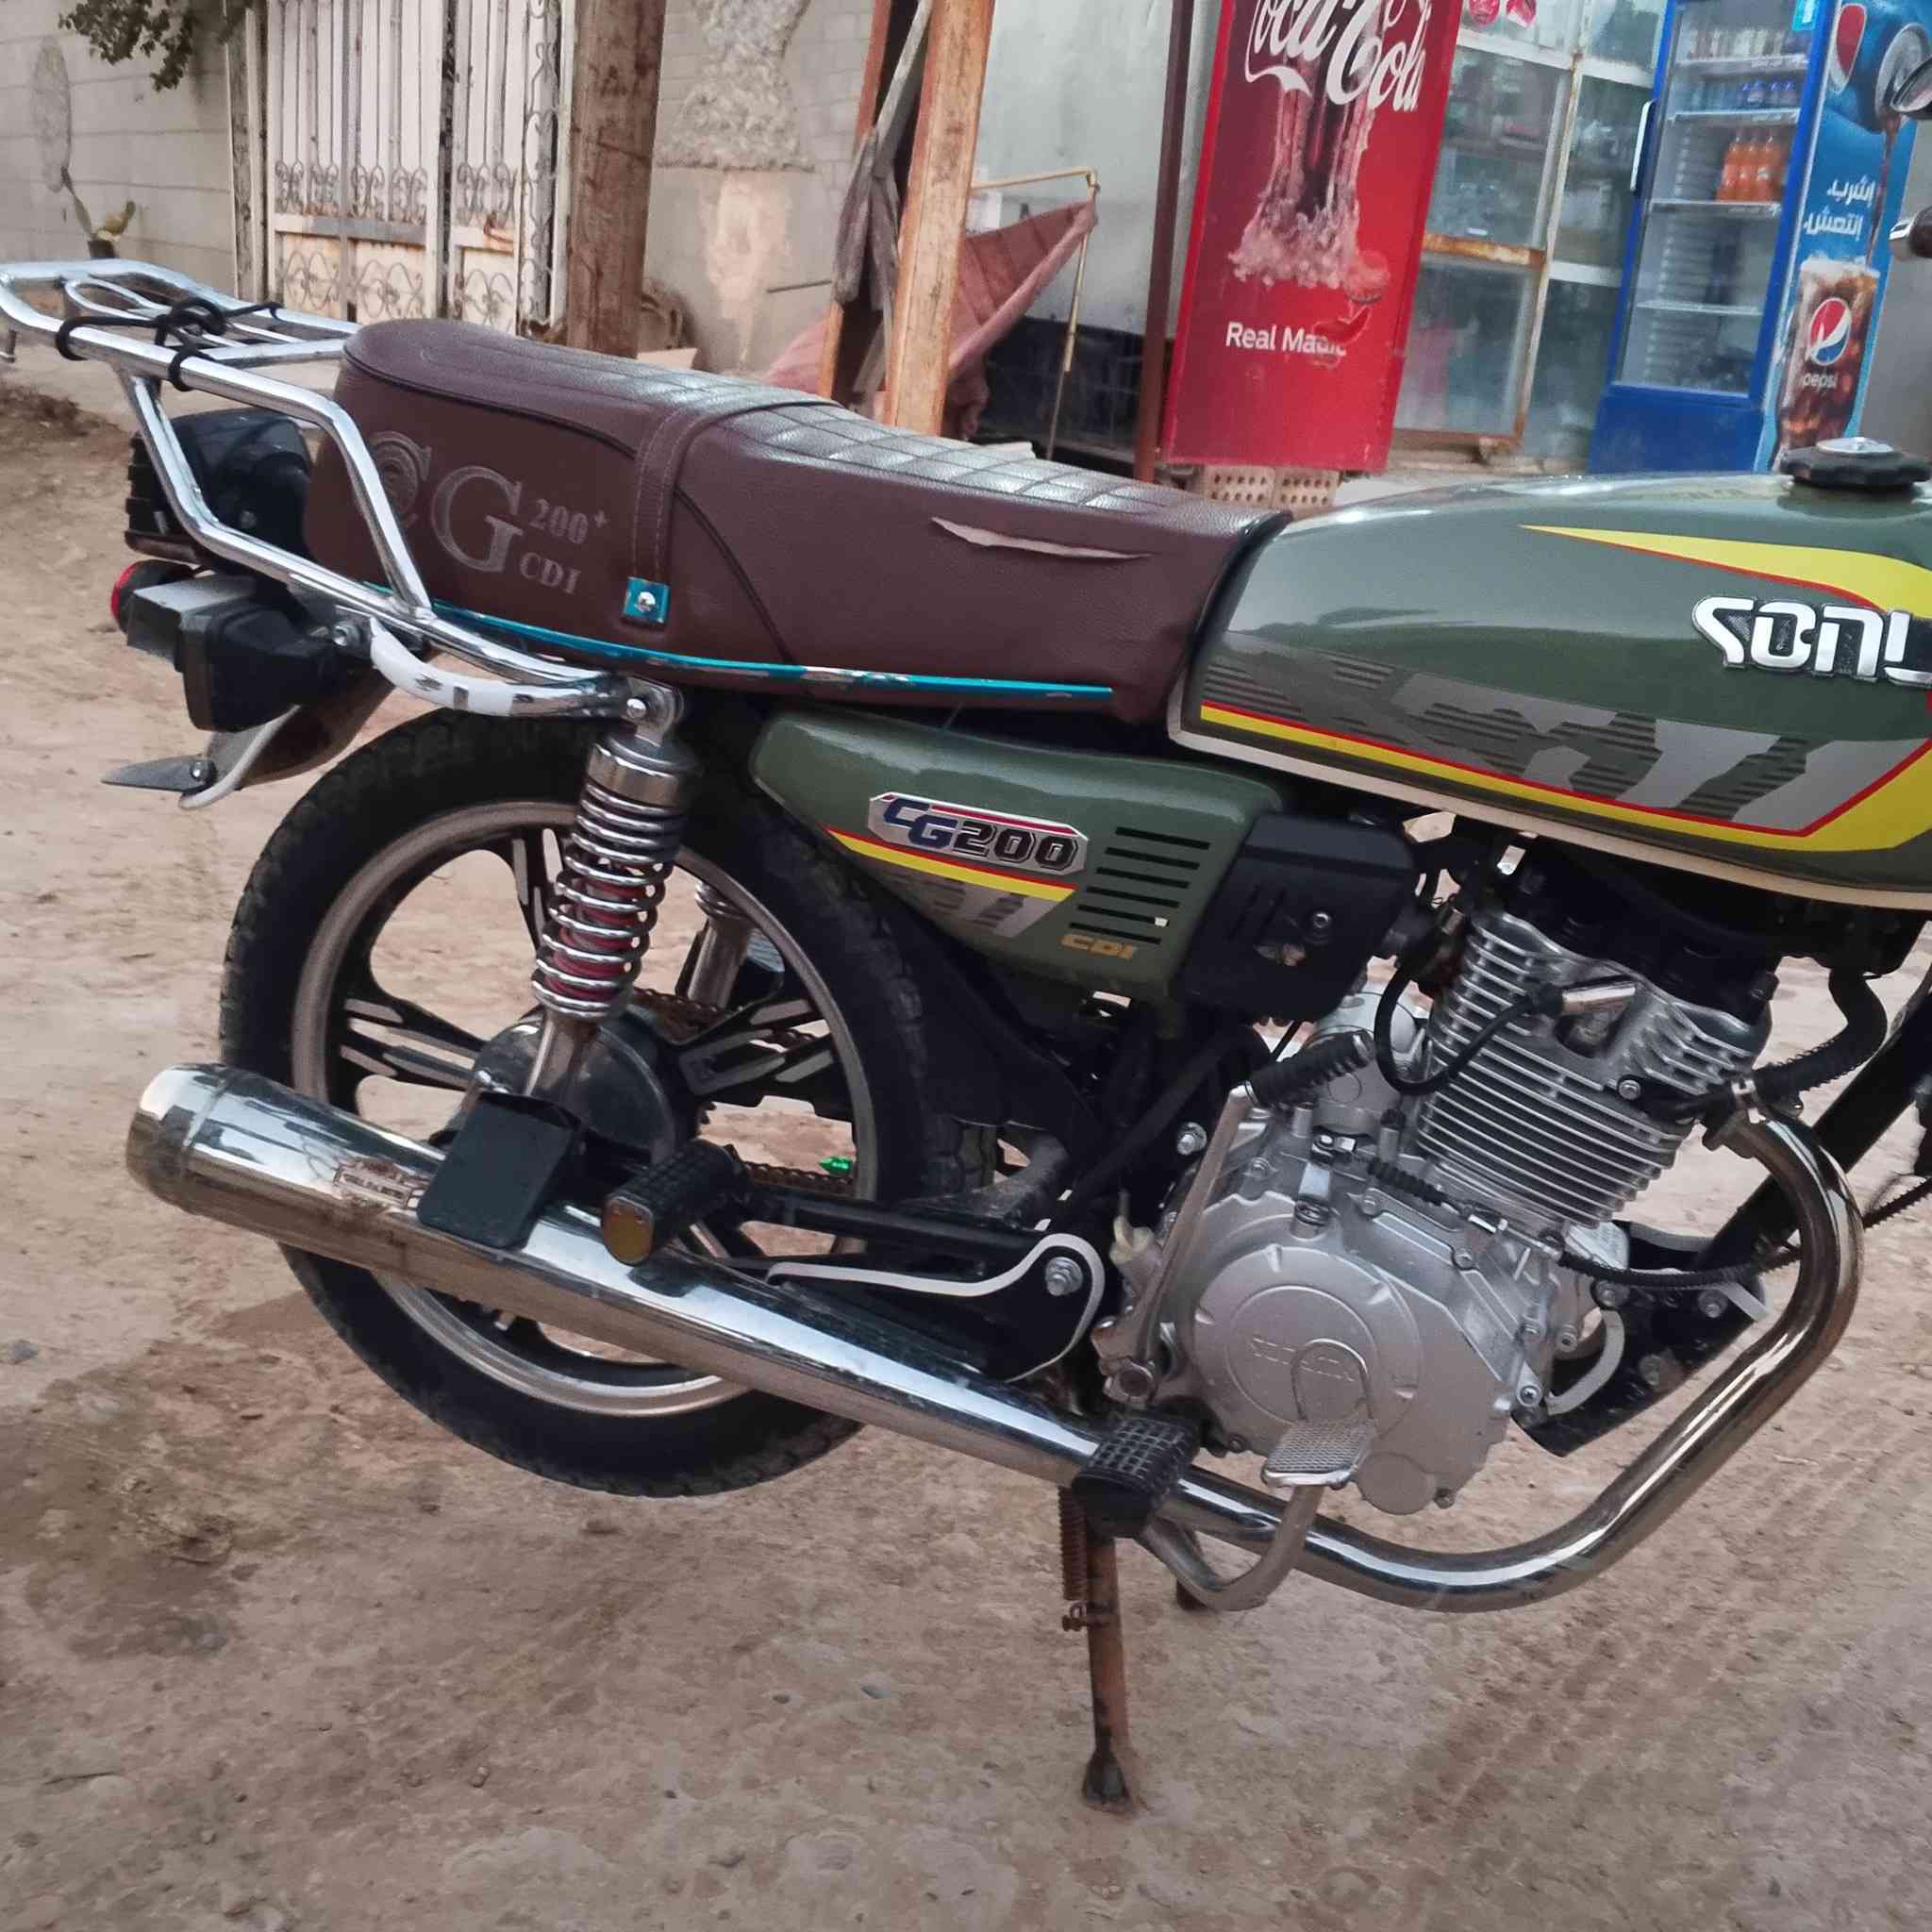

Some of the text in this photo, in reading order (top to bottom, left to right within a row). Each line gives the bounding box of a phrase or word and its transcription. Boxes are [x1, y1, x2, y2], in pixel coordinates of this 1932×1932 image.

[1226, 321, 1276, 351] Real
[519, 551, 581, 594] CDI
[883, 798, 1079, 872] CG200
